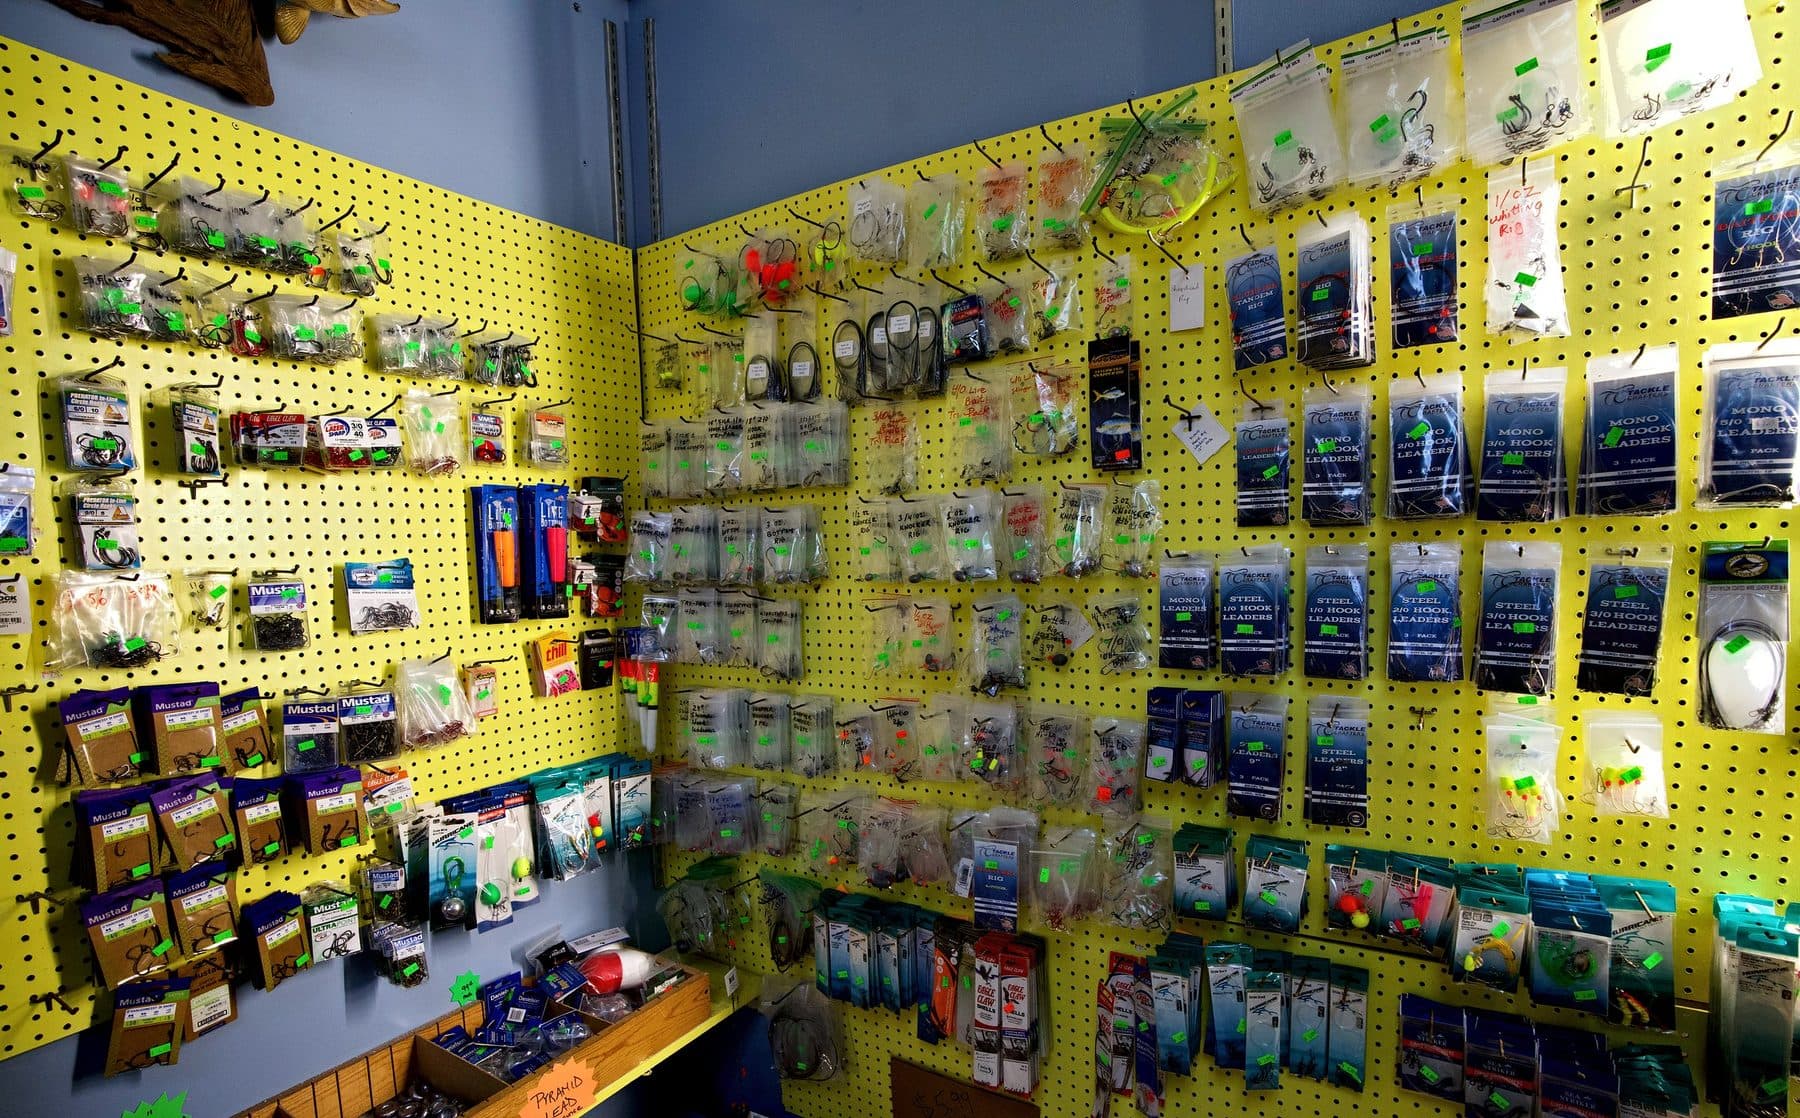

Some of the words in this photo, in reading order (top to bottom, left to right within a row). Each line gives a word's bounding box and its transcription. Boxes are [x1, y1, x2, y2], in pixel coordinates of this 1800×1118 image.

[1236, 290, 1275, 306] TANDEM
[1247, 300, 1263, 311] RIG
[1628, 385, 1670, 396] TACKLE
[1518, 400, 1556, 408] TACKLE
[1329, 410, 1360, 418] TACKLE
[1731, 406, 1786, 414] MONO
[1609, 415, 1659, 427] MONO
[1720, 418, 1742, 426] 5/0
[1498, 428, 1543, 436] MONO
[1624, 424, 1671, 436] HOOK
[1717, 427, 1798, 437] LEADERS
[1315, 435, 1351, 444] MONO
[1487, 439, 1505, 447] 3/0
[1511, 439, 1552, 447] HOOK
[1305, 455, 1360, 464] LEADERS
[1486, 450, 1551, 458] LEADERS
[908, 529, 921, 538] RIG
[955, 526, 970, 535] RIG
[1495, 602, 1541, 610] STEEL
[1600, 600, 1650, 610] STEEL
[1308, 615, 1361, 623] LEADERS
[1392, 616, 1449, 624] LEADERS
[1486, 612, 1505, 620] 3/0
[1511, 613, 1549, 622] HOOK
[1591, 611, 1611, 619] 3/0
[1615, 612, 1658, 621] HOOK
[1486, 623, 1549, 632] LEARS
[1588, 620, 1657, 633] LEADERS
[1616, 641, 1640, 649] PACK
[546, 642, 567, 661] chill
[155, 700, 193, 711] Mustad
[342, 694, 390, 707] Mustad
[65, 707, 104, 722] Mustad
[288, 703, 335, 715] Mustad
[1232, 749, 1278, 758] LEADERS
[308, 786, 340, 798] Mustad
[159, 793, 193, 812] Mustad
[237, 795, 265, 808] Mustad
[92, 809, 128, 823] Mustad
[372, 871, 399, 880] Mustad
[172, 881, 207, 897] Mustad
[88, 904, 128, 925] Mustad
[257, 917, 284, 934] Mustad
[312, 921, 337, 934] ULTRA
[394, 934, 423, 948] Mustad
[977, 985, 997, 998] EAGLE
[976, 996, 996, 1008] CLAW
[530, 1075, 583, 1110] PYRAMID
[545, 1096, 577, 1118] LEAD
